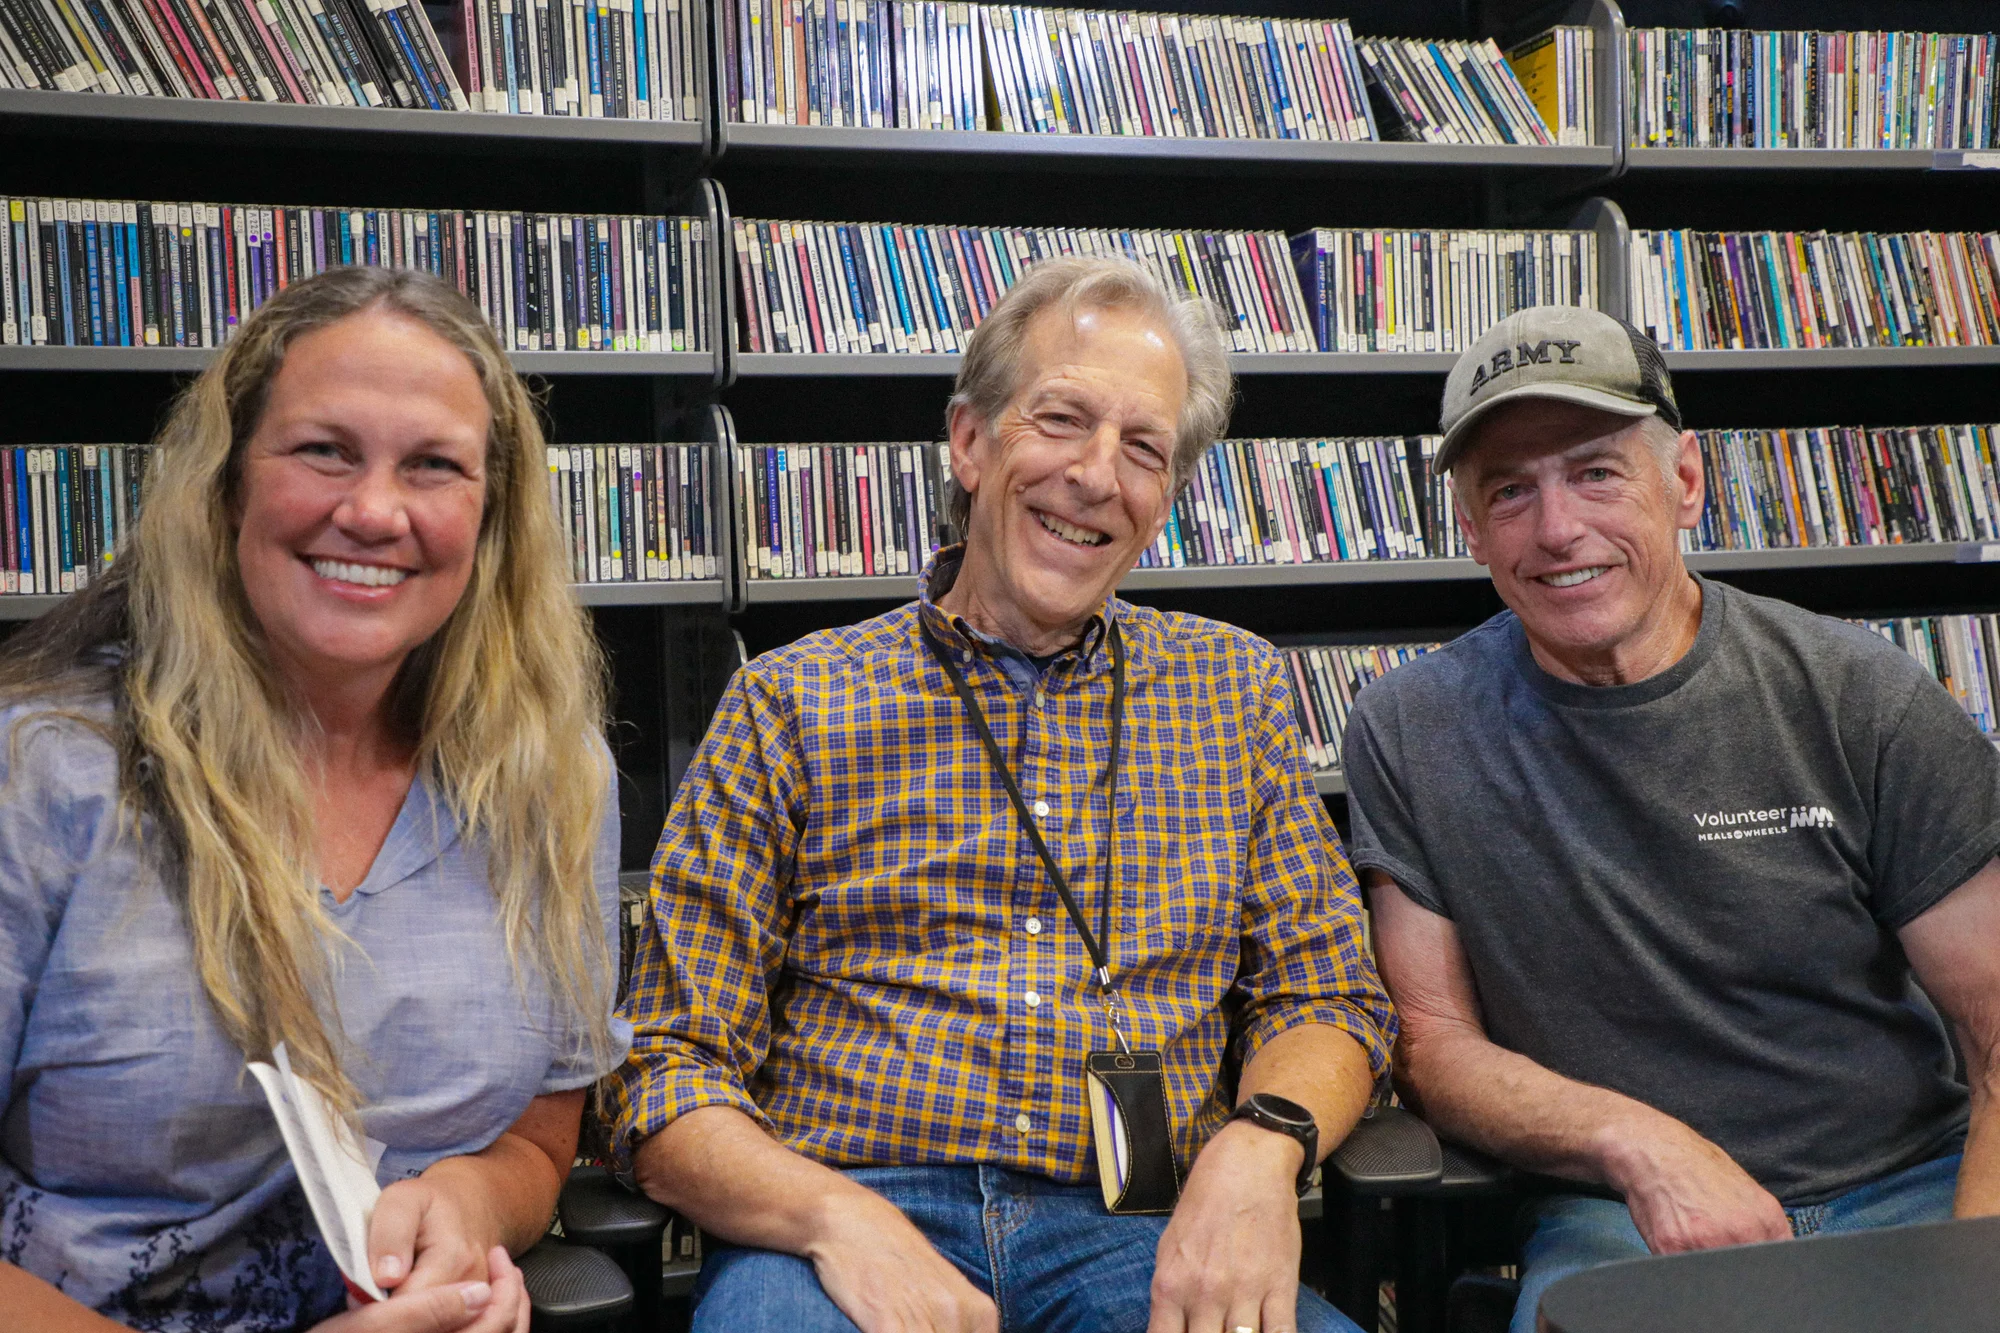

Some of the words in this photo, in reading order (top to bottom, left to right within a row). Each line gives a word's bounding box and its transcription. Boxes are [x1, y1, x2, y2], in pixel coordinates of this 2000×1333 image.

[152, 13, 161, 23] THE
[31, 55, 39, 65] THE
[1470, 340, 1580, 396] ARMY
[1694, 808, 1787, 827] Volunteer
[1698, 832, 1733, 841] MEALS
[1743, 826, 1788, 837] WHEELS
